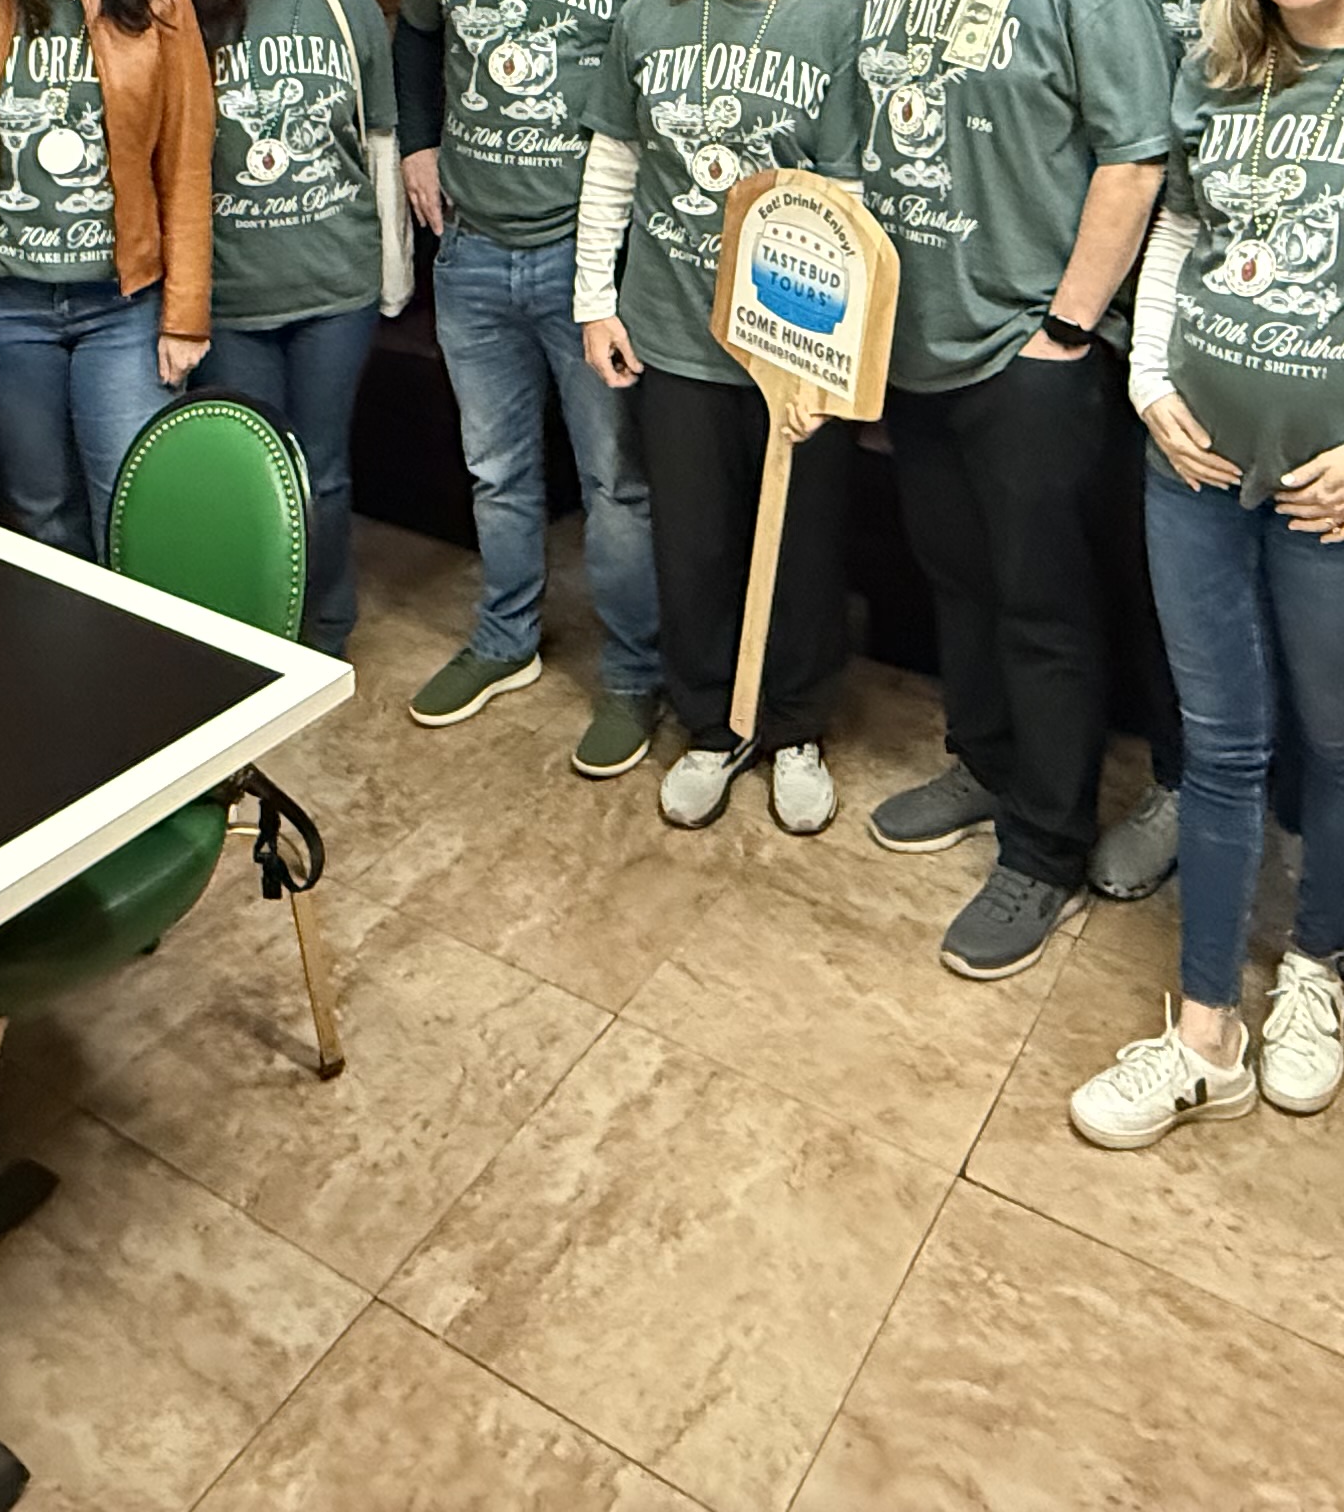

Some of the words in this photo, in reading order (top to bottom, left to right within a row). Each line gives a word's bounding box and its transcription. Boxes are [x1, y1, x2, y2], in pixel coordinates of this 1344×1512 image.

[214, 40, 252, 87] EW
[259, 34, 357, 90] ORLEAN
[634, 43, 703, 96] NEW
[704, 42, 831, 120] ORLEANS
[472, 125, 504, 148] 70th
[506, 125, 590, 160] Birthday
[965, 115, 994, 133] 1956
[471, 150, 503, 165] MAKE
[504, 154, 516, 166] IT
[517, 156, 563, 169] SHITTY!
[263, 197, 299, 216] 70th
[268, 215, 301, 229] MAKE
[301, 212, 313, 224] IT
[898, 194, 979, 241] Birthday
[17, 226, 61, 248] 70th
[757, 195, 781, 221] Eat!
[783, 193, 823, 216] Drink!
[822, 207, 856, 259] Enjoy!
[63, 250, 78, 264] IT
[762, 244, 842, 289] TASTEBUD
[769, 270, 829, 307] TOURS
[736, 305, 778, 337] COME
[782, 328, 853, 375] HUNGRY!
[1205, 310, 1249, 348] 70th
[734, 325, 849, 393] TASTEBUDTOURS.COM
[1207, 344, 1243, 366] MAKE
[1245, 354, 1261, 370] IT
[1263, 358, 1328, 381] SHITTY!
